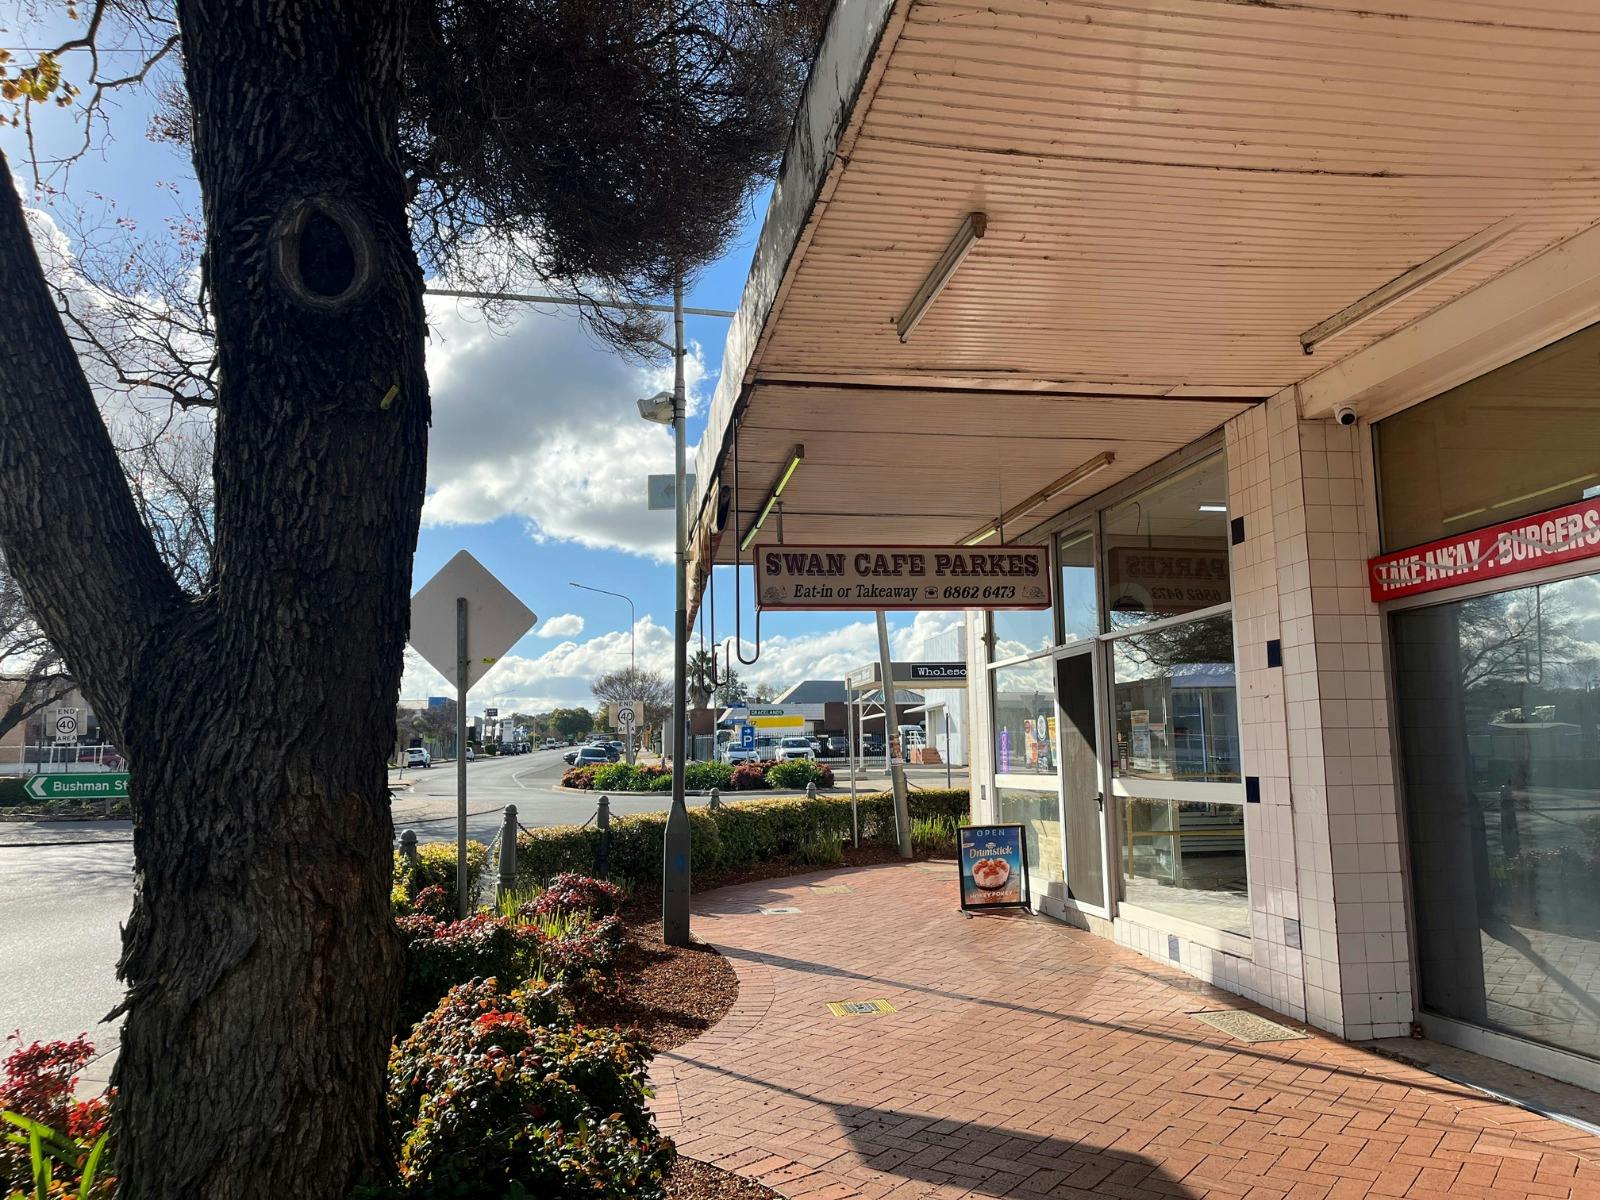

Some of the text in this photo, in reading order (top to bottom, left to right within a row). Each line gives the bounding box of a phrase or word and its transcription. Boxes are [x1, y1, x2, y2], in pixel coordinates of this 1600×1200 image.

[1379, 509, 1600, 591] TAKE AWAY BURGERS
[765, 552, 1040, 577] SWAN CAFE PARKES
[793, 584, 1016, 601] Eat-in or Takeaway 6862 6473
[620, 712, 633, 721] 40
[59, 720, 75, 730] 40
[743, 735, 753, 747] P
[53, 780, 128, 792] Bushman St
[976, 829, 1005, 837] OPEN
[969, 845, 1013, 859] Drumstick
